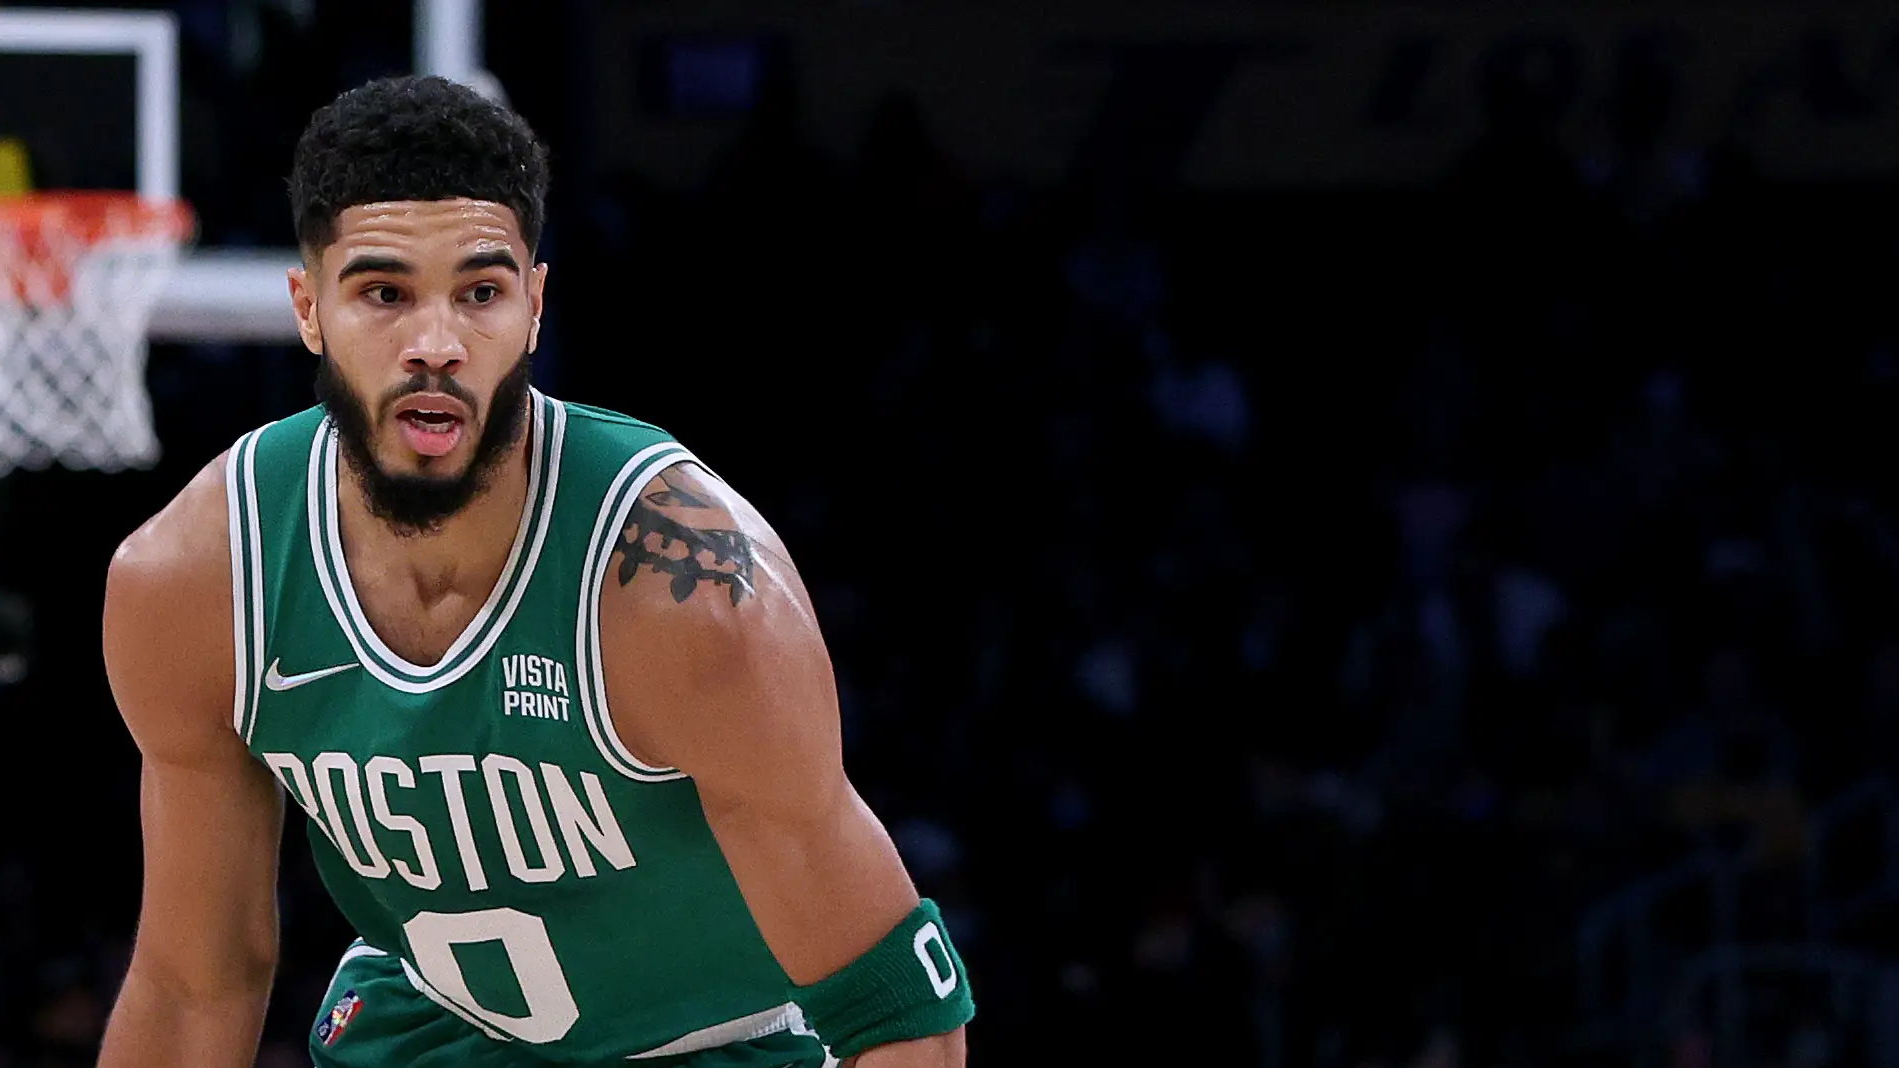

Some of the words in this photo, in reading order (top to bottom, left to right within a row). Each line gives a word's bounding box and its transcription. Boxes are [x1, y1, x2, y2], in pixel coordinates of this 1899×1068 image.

[502, 654, 570, 697] VISTA
[503, 690, 570, 723] PRINT
[402, 906, 580, 1044] 0
[913, 921, 958, 999] 0
